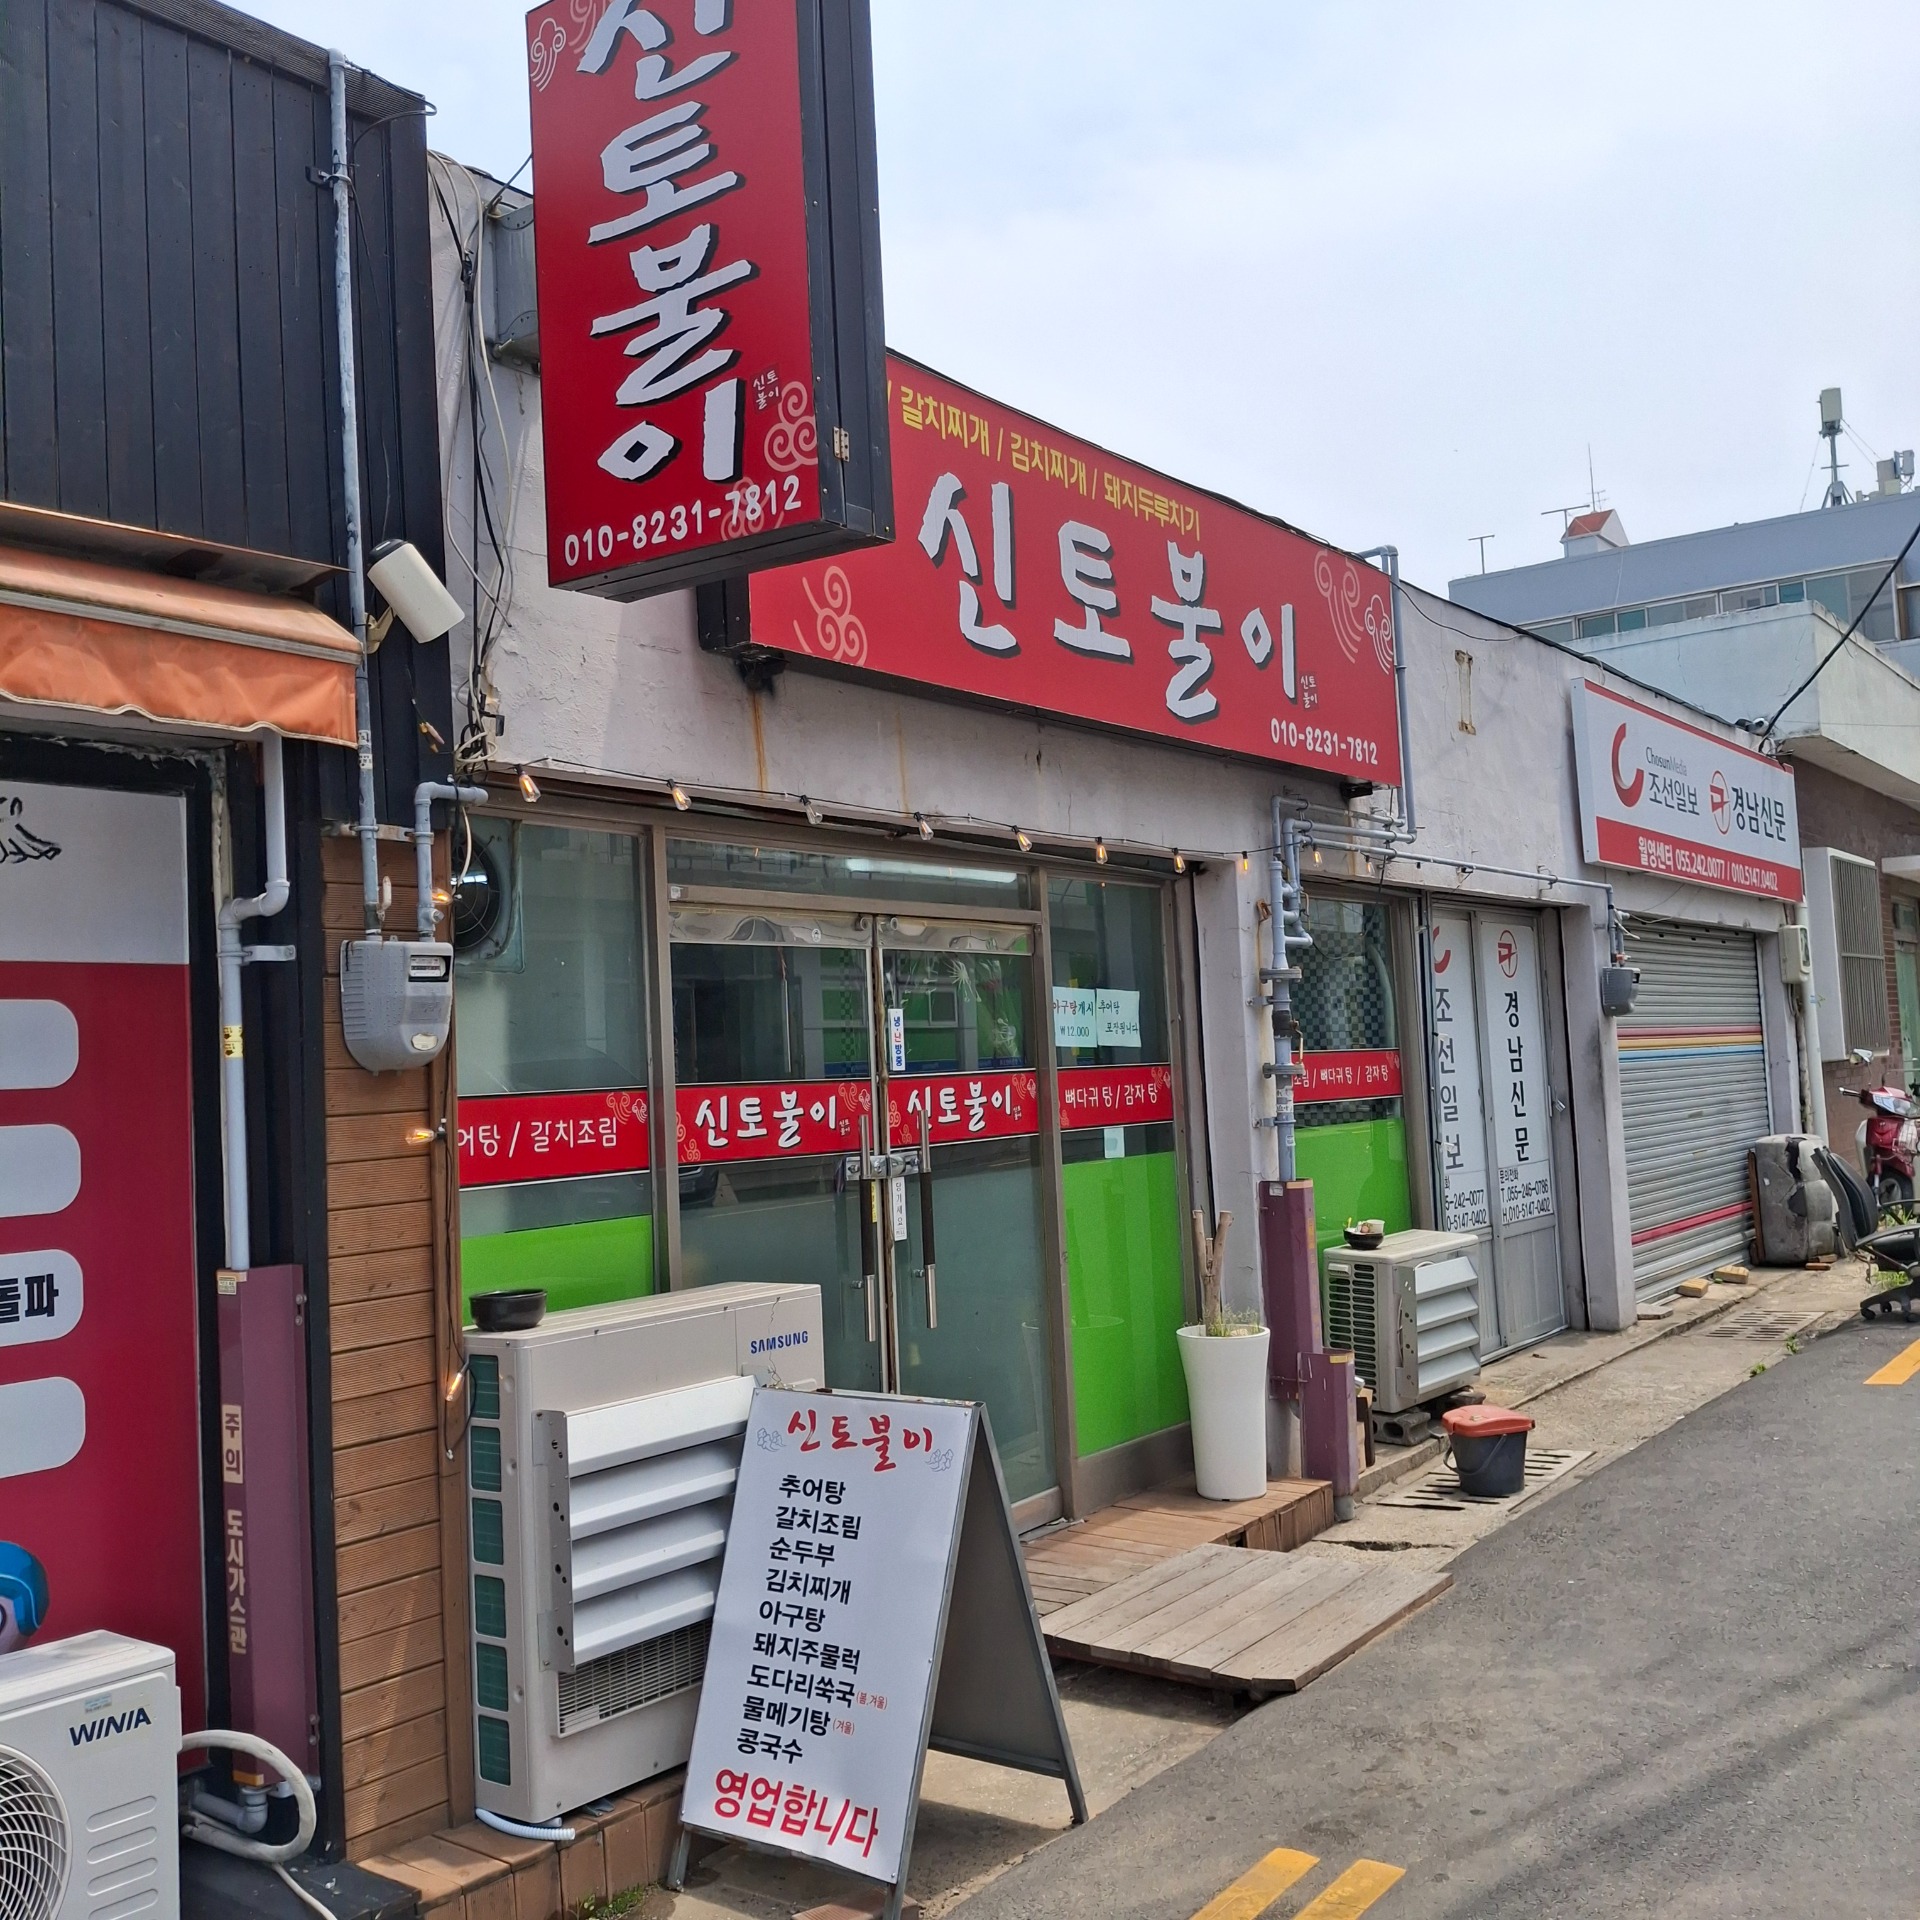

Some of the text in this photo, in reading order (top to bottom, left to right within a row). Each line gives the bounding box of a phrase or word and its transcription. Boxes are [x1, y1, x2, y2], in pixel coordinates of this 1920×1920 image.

[577, 0, 752, 482] 신토불이
[753, 369, 778, 391] 신토
[755, 386, 779, 410] 불이
[900, 386, 990, 457] 갈치찌개
[1010, 432, 1087, 496] 김치찌개
[1104, 472, 1201, 541] 돼지두루치기
[564, 475, 801, 567] 010-8231-7812
[918, 471, 1297, 723] 신토불이
[1300, 675, 1317, 690] 신토
[1303, 692, 1318, 709] 불이
[1270, 718, 1378, 765] 010-8231-7812
[1648, 772, 1700, 816] 조선일보
[1731, 786, 1787, 842] 경남신문
[1638, 836, 1674, 872] 월영센터
[1675, 848, 1725, 880] 055.242.0077
[1731, 862, 1779, 891] 010.5147.0402
[1098, 1000, 1120, 1015] 추어탕
[1435, 988, 1464, 1170] 조선일보
[1504, 991, 1529, 1162] 경남신문
[695, 1091, 836, 1148] 신토불이
[907, 1081, 1011, 1132] 신토불이
[530, 1117, 617, 1153] 갈치조림
[1500, 1169, 1518, 1184] 문의전화
[750, 1330, 808, 1355] SAMSUNG
[224, 1412, 241, 1476] 주의
[787, 1409, 934, 1472] 신토불이
[778, 1474, 846, 1505] 추어탕
[775, 1506, 862, 1540] 갈치조림
[769, 1536, 835, 1568] 순두부
[226, 1509, 248, 1655] 도시가스관
[766, 1568, 852, 1606] 김치찌개
[759, 1600, 826, 1633] 아구탕
[753, 1632, 861, 1675] 돼지주물럭
[747, 1664, 855, 1709] 도다리쑥국
[69, 1707, 152, 1747] WINIA
[743, 1695, 831, 1736] 물메기탕
[737, 1727, 803, 1765] 콩국수
[714, 1768, 880, 1859] 영업합니다
